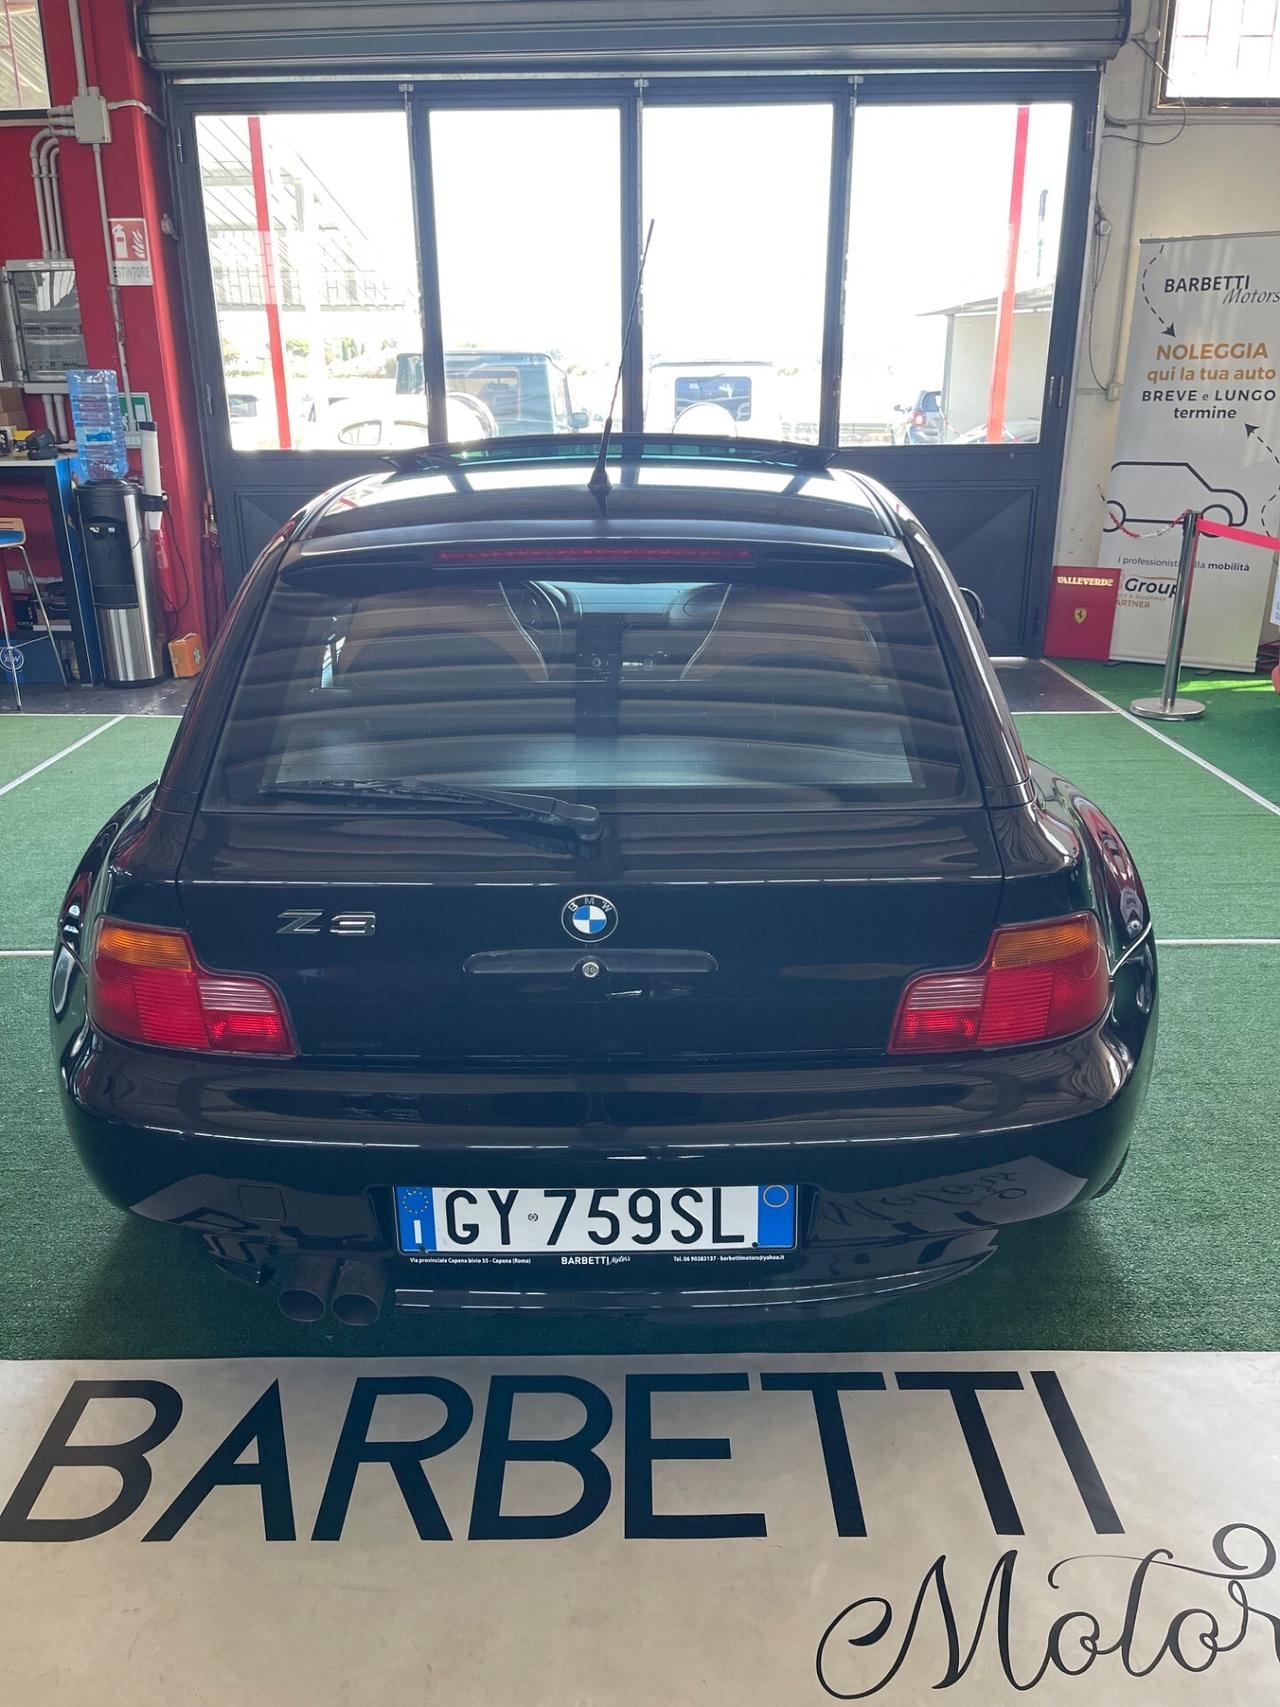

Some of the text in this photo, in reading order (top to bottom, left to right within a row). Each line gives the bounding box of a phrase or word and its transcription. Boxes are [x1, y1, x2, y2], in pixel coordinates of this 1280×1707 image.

[1164, 275, 1250, 293] BARBETTI
[1156, 343, 1269, 361] NOLEGGIA
[1147, 366, 1276, 384] qui la tua auto
[1142, 389, 1276, 402] BREVE e LUNGO
[1174, 405, 1237, 419] termine
[1122, 556, 1179, 569] professionist
[1207, 562, 1250, 572] mobilità
[1057, 576, 1113, 587] VALLEVERDE
[1117, 600, 1151, 609] ARTNER
[275, 908, 377, 937] Z3
[445, 1188, 519, 1246] GY
[543, 1186, 745, 1246] 759SL
[561, 1256, 610, 1266] BARBETTI
[0, 1370, 1126, 1543] BARBETTI
